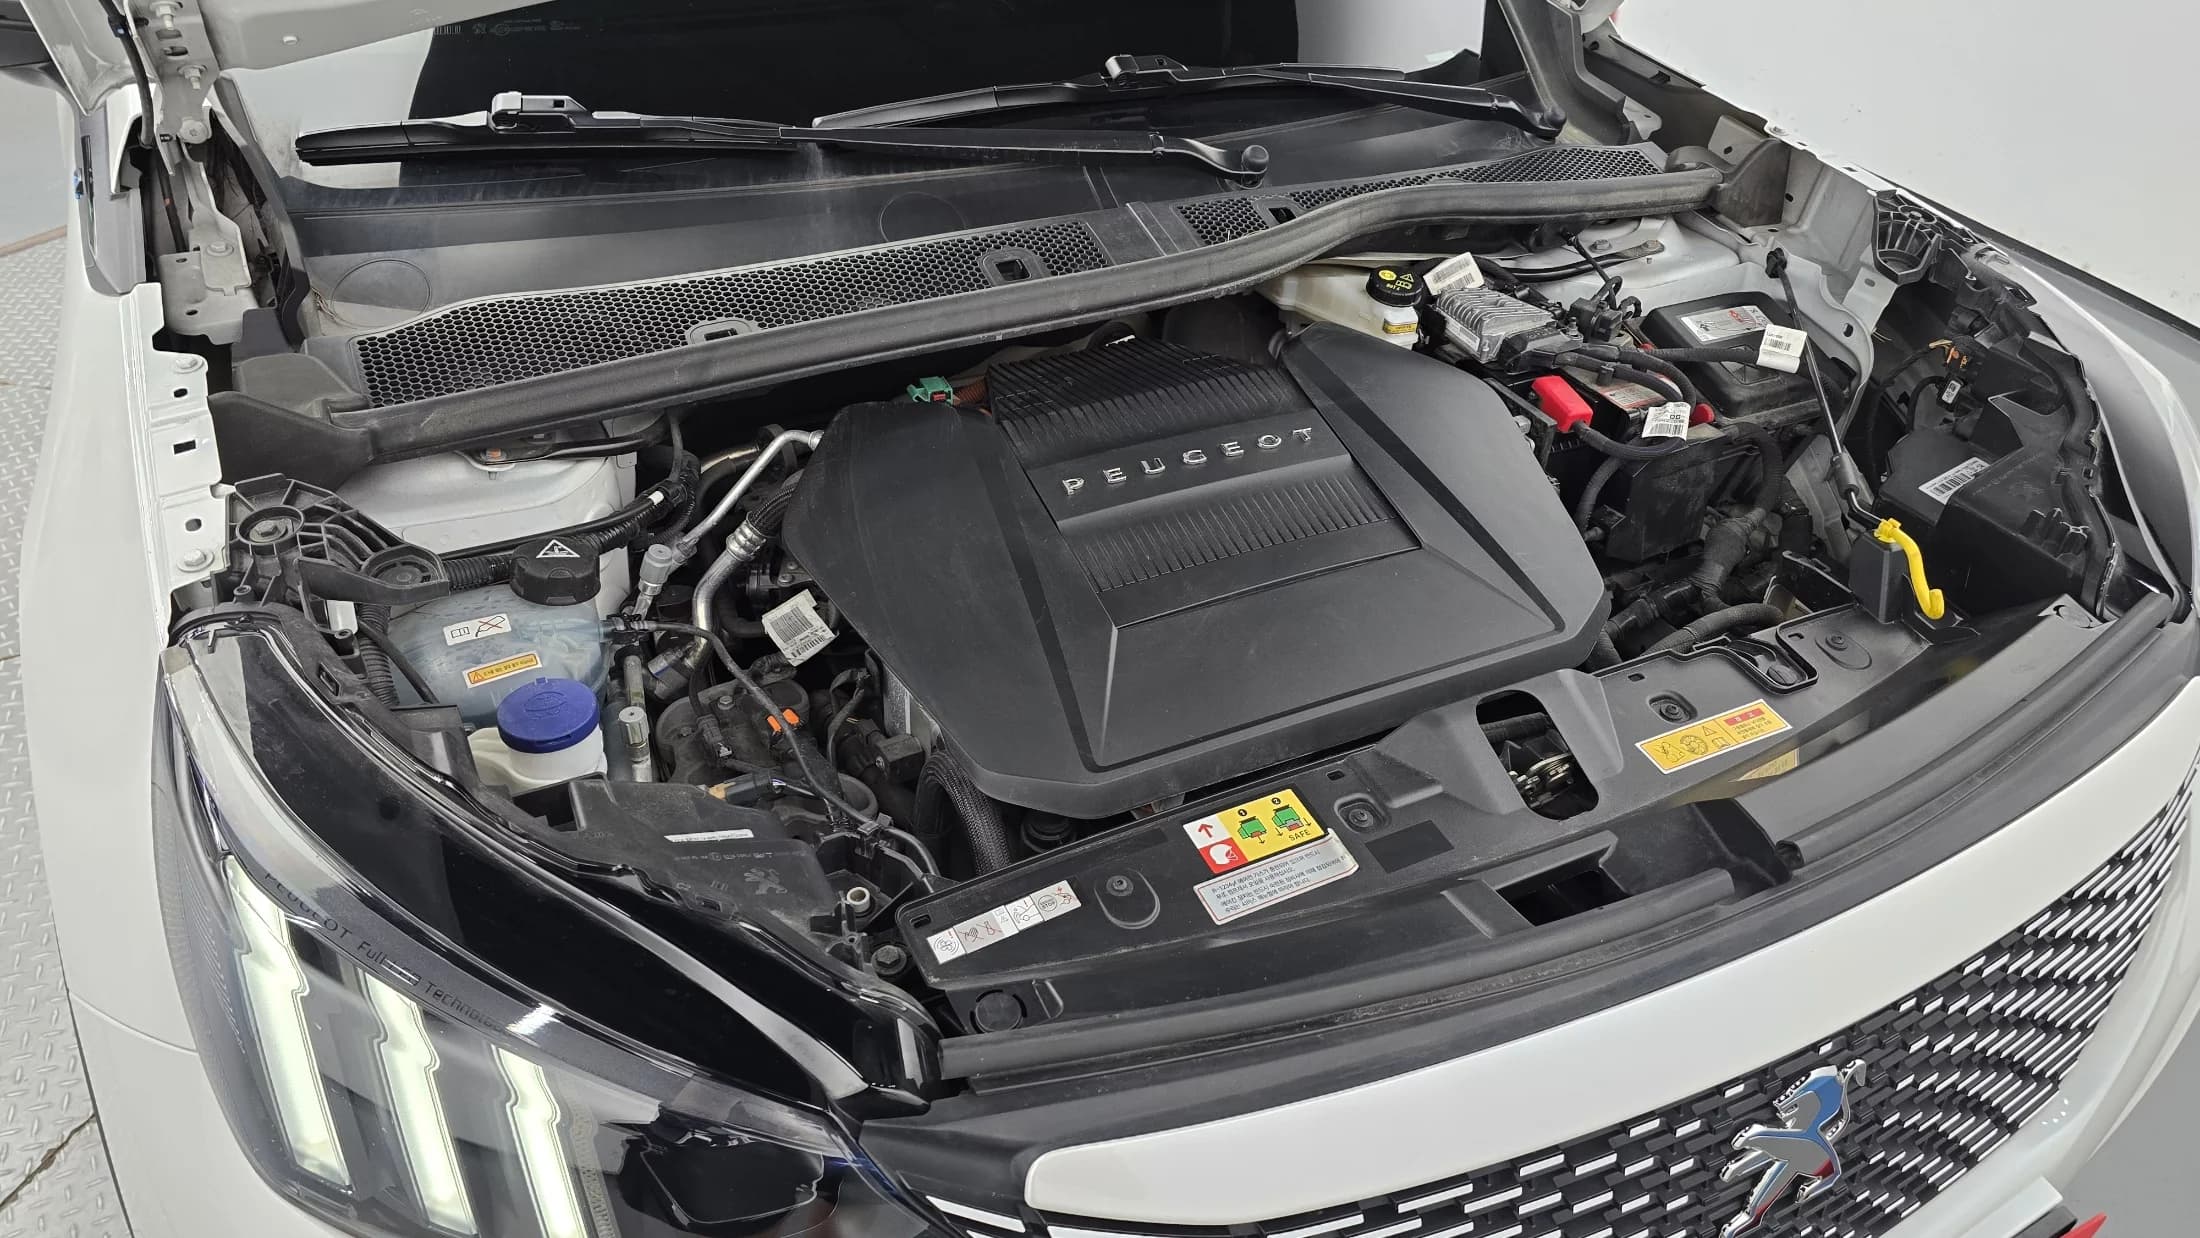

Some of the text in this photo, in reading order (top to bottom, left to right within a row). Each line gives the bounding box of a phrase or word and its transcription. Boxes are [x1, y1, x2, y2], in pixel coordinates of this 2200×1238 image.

[1062, 427, 1312, 495] PEUGEOT
[1289, 829, 1311, 842] SAFE
[357, 940, 386, 966] Full
